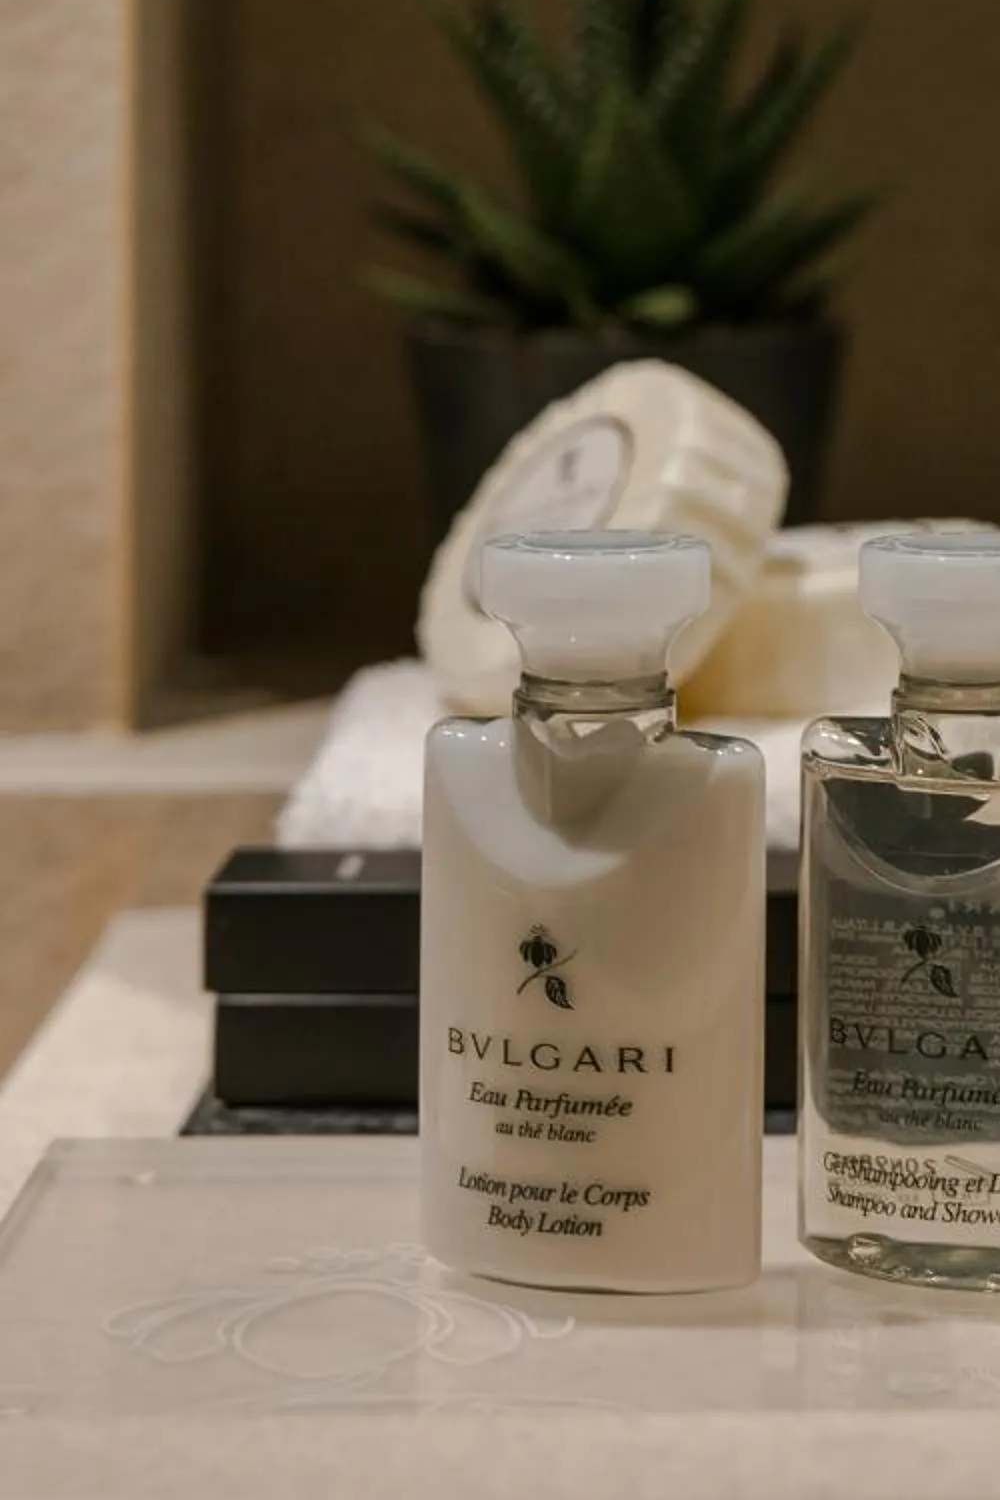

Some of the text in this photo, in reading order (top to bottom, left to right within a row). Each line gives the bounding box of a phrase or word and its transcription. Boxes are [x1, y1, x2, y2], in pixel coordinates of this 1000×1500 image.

[447, 1027, 675, 1073] BVLGARI
[469, 1082, 634, 1120] Eau Parfumée
[494, 1121, 598, 1145] au thé blanc
[458, 1166, 651, 1211] Lotion pour le Corps
[827, 1182, 897, 1217] Shampoo
[900, 1199, 938, 1222] and
[965, 1173, 988, 1194] et
[487, 1204, 603, 1237] Body Lotion
